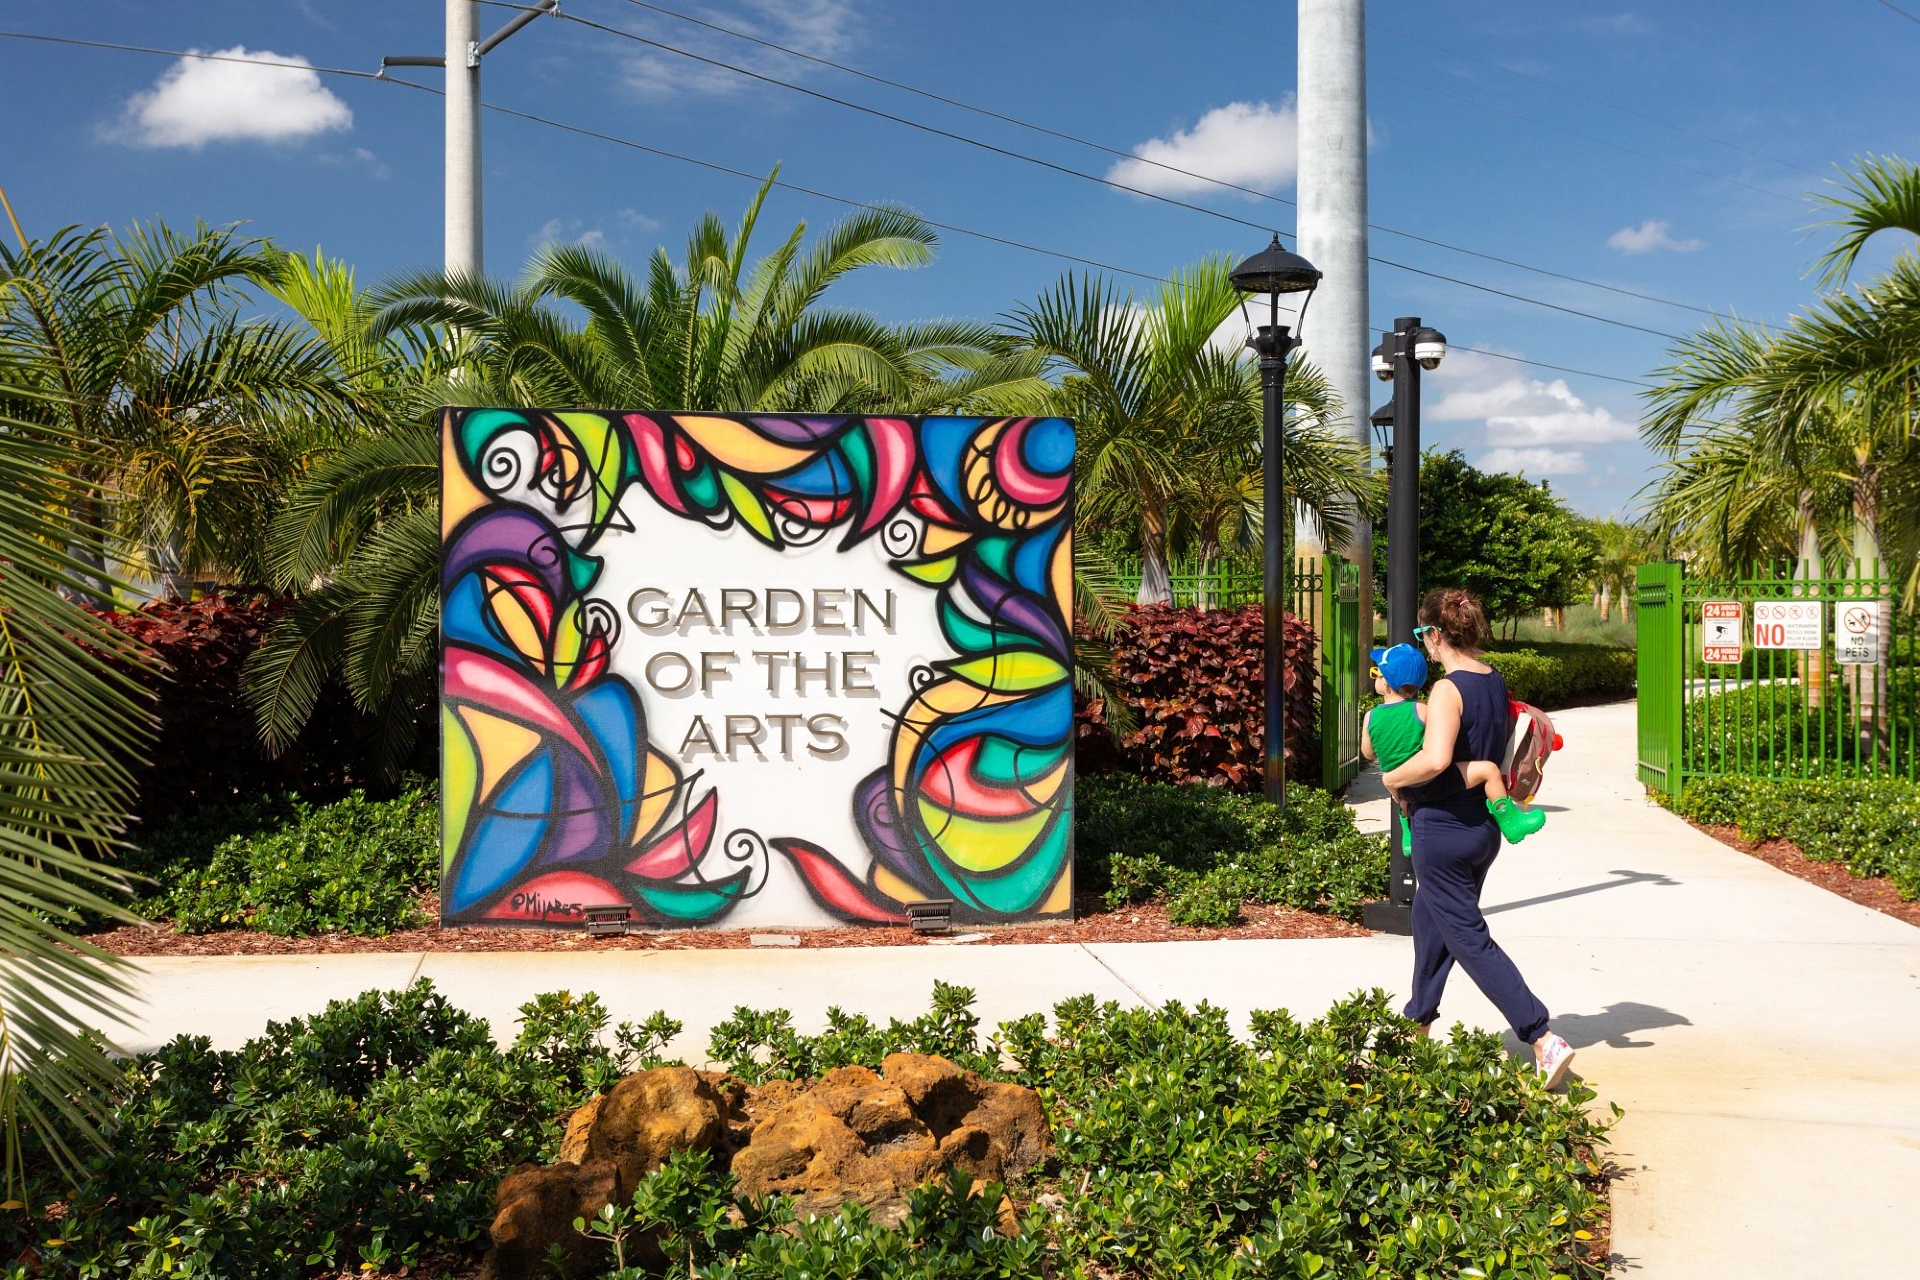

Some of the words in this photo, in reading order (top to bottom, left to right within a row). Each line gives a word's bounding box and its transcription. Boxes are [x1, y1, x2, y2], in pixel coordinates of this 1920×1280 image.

[627, 587, 893, 628] GARDEN
[1705, 604, 1720, 616] 24
[1756, 623, 1785, 646] NO
[1851, 636, 1864, 646] NO
[1705, 648, 1720, 660] 24
[1845, 647, 1869, 657] PETS
[645, 650, 736, 692] OF
[752, 650, 875, 691] THE
[677, 713, 843, 755] ARTS
